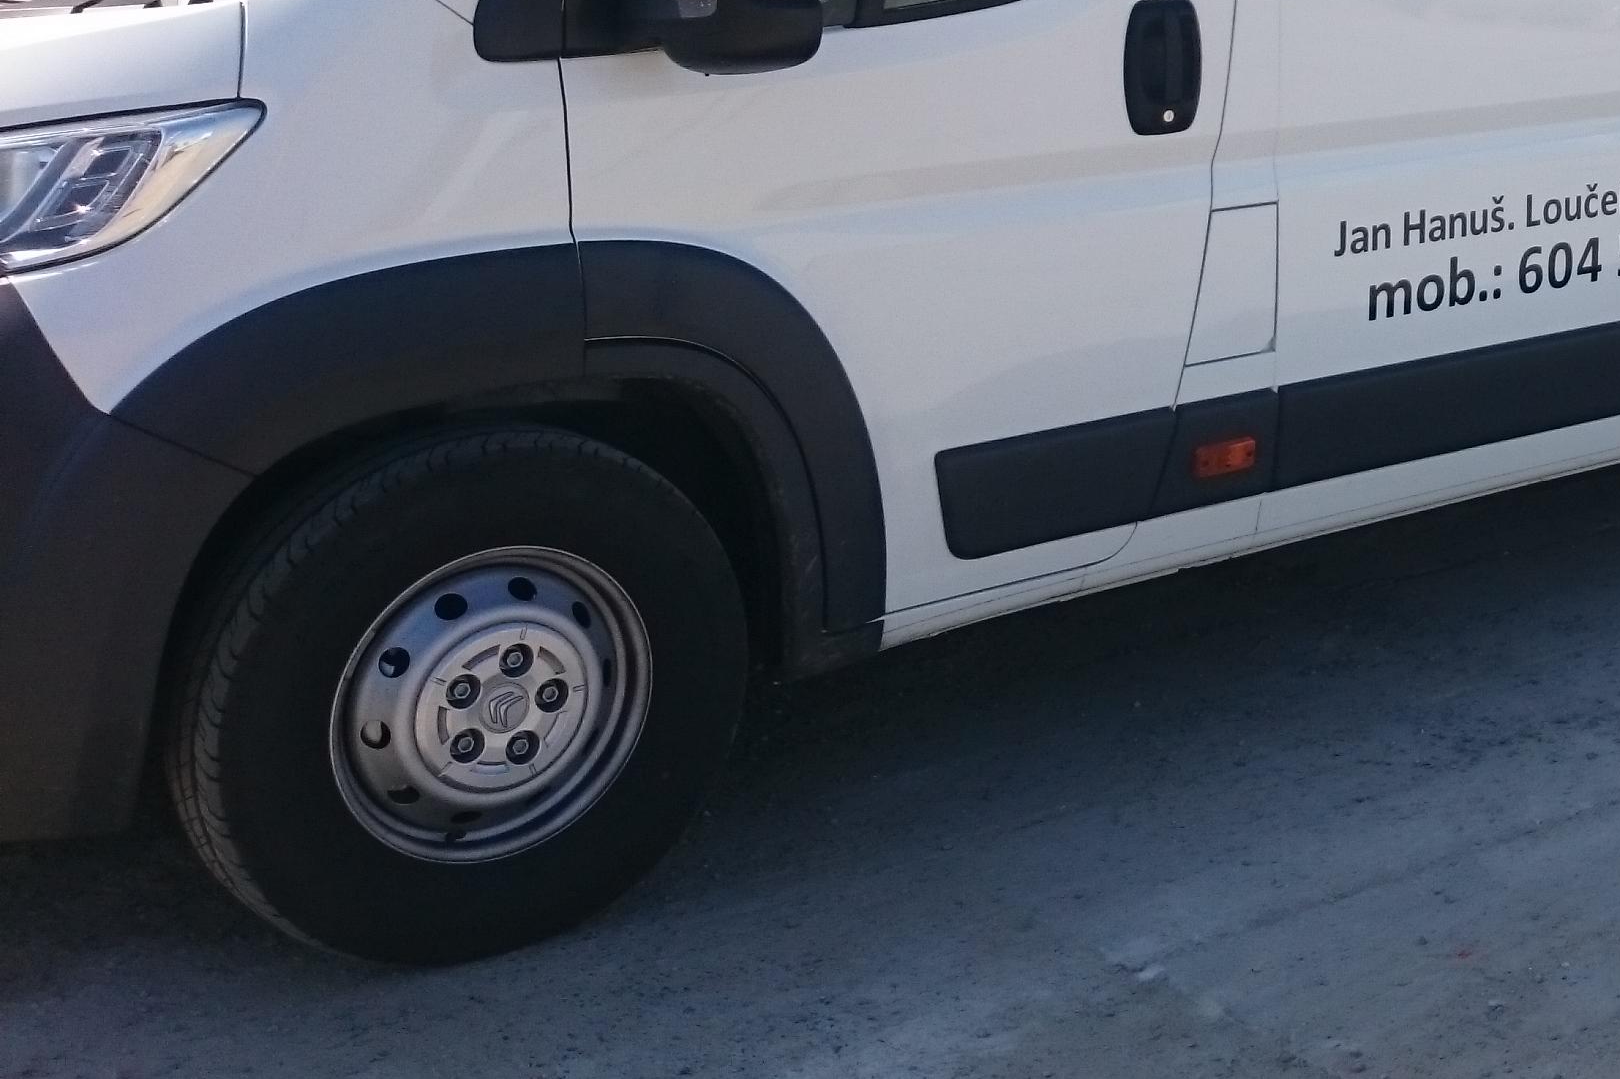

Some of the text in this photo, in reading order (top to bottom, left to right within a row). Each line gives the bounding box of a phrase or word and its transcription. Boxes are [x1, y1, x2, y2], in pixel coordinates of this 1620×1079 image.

[1334, 219, 1391, 257] Jan
[1403, 196, 1515, 246] Hanuš.
[1368, 256, 1502, 321] mob.:
[1518, 237, 1602, 295] 604
